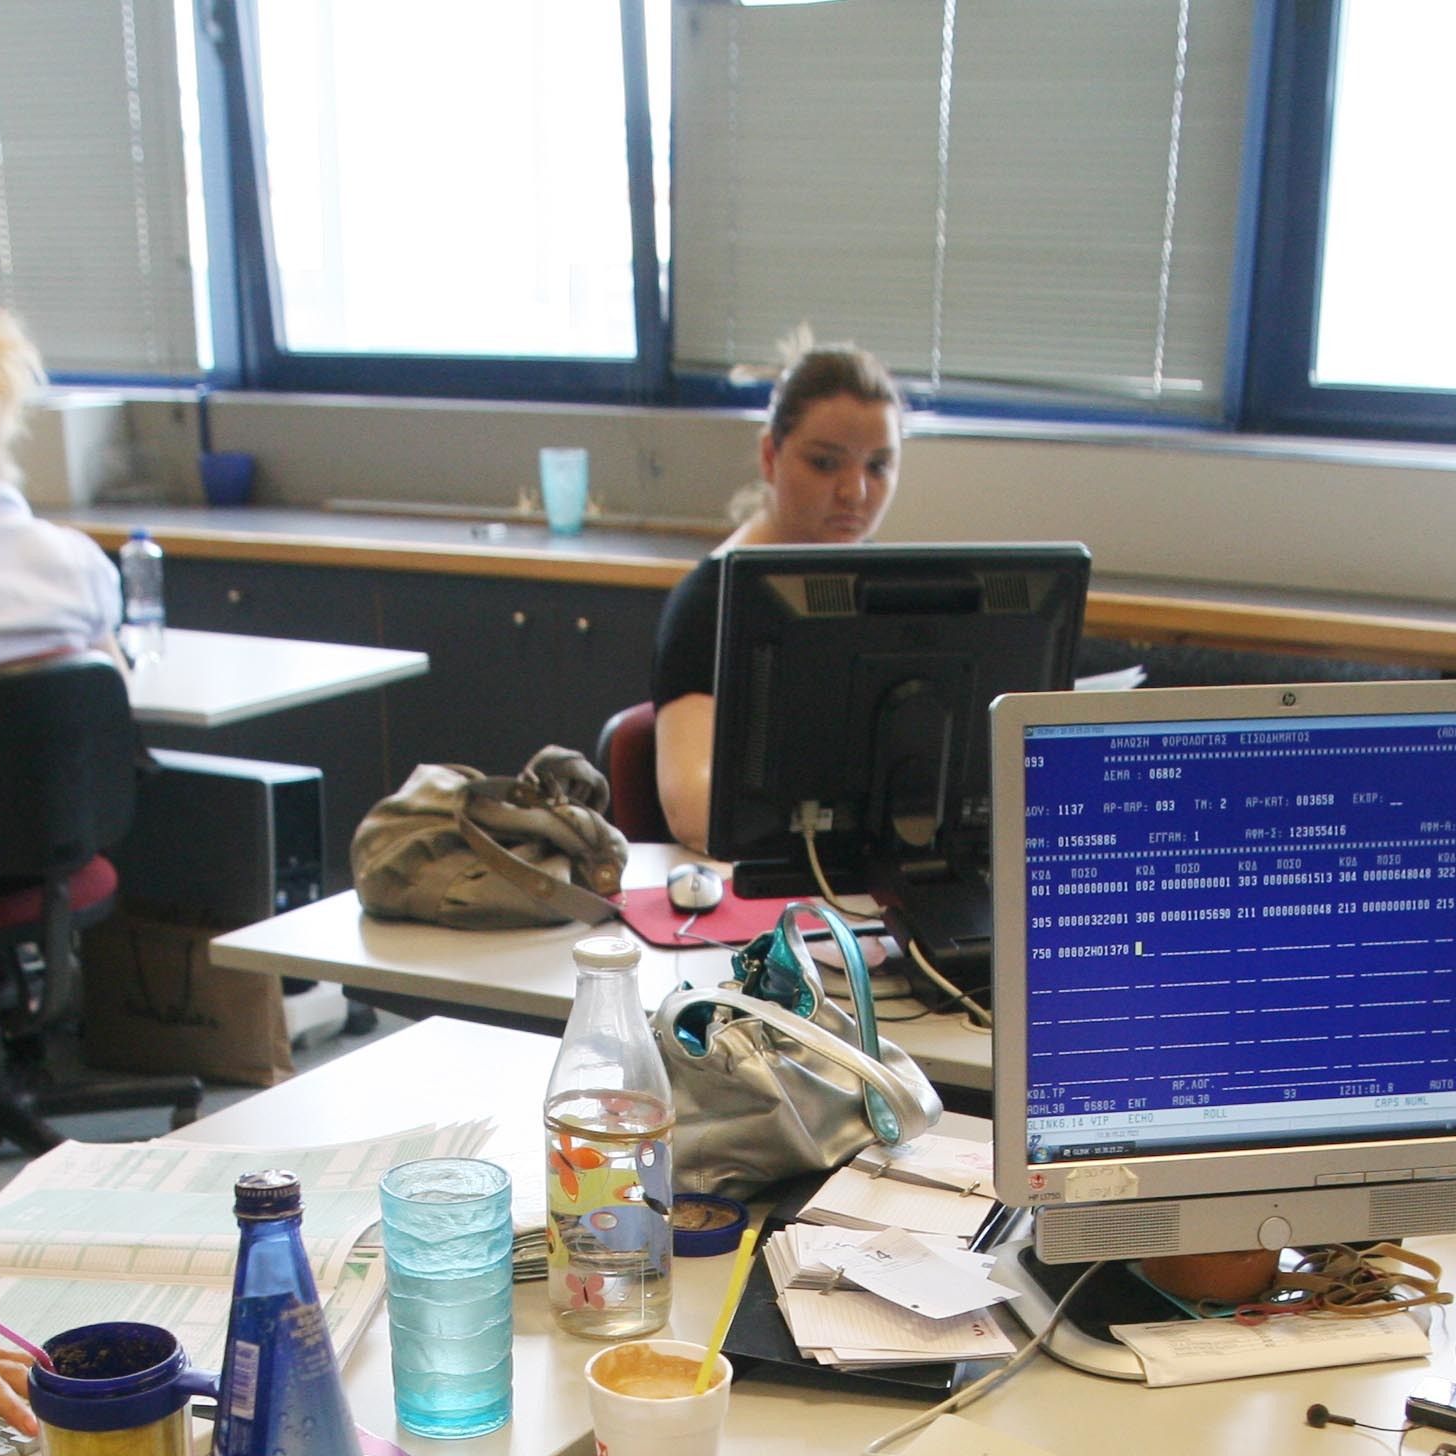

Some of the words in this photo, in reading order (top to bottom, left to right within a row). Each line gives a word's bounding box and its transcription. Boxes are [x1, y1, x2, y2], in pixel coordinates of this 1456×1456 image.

[1110, 737, 1150, 749] ΔΗΛΩΣΗ
[1162, 734, 1227, 748] ΦΟΡΟΛΟΓΙΑΣ
[1149, 767, 1182, 780] 06802
[1058, 804, 1084, 816] 1137
[1155, 800, 1175, 812] 093
[1220, 798, 1227, 809] 2
[1194, 831, 1200, 842] 1
[1031, 870, 1052, 881] ΚΩΔ
[1071, 867, 1098, 879] ΠΟΣΟ
[1136, 865, 1155, 876] ΚΩΔ
[1174, 862, 1200, 874] ΠΟΣΟ
[1238, 860, 1258, 872] ΚΩΔ
[1276, 858, 1302, 870] ΠΟΣΟ
[1031, 885, 1050, 896] 001
[1135, 880, 1155, 892] 002
[1238, 875, 1258, 887] 303
[1338, 871, 1357, 884] 304
[1437, 867, 1456, 879] 322
[1032, 917, 1052, 929] 305
[1135, 912, 1155, 924] 306
[1237, 907, 1256, 919] 211
[1337, 902, 1357, 914] 213
[1436, 898, 1455, 910] 215
[1032, 948, 1052, 960] 750
[1084, 1100, 1116, 1112] 06802
[1128, 1097, 1148, 1109] ENT
[1283, 1088, 1297, 1099] 93
[1429, 1079, 1454, 1090] AUTO
[1091, 1115, 1109, 1126] VIP
[1128, 1112, 1154, 1124] ECHO
[1203, 1108, 1229, 1120] ROLL
[1374, 1097, 1399, 1109] CAPS
